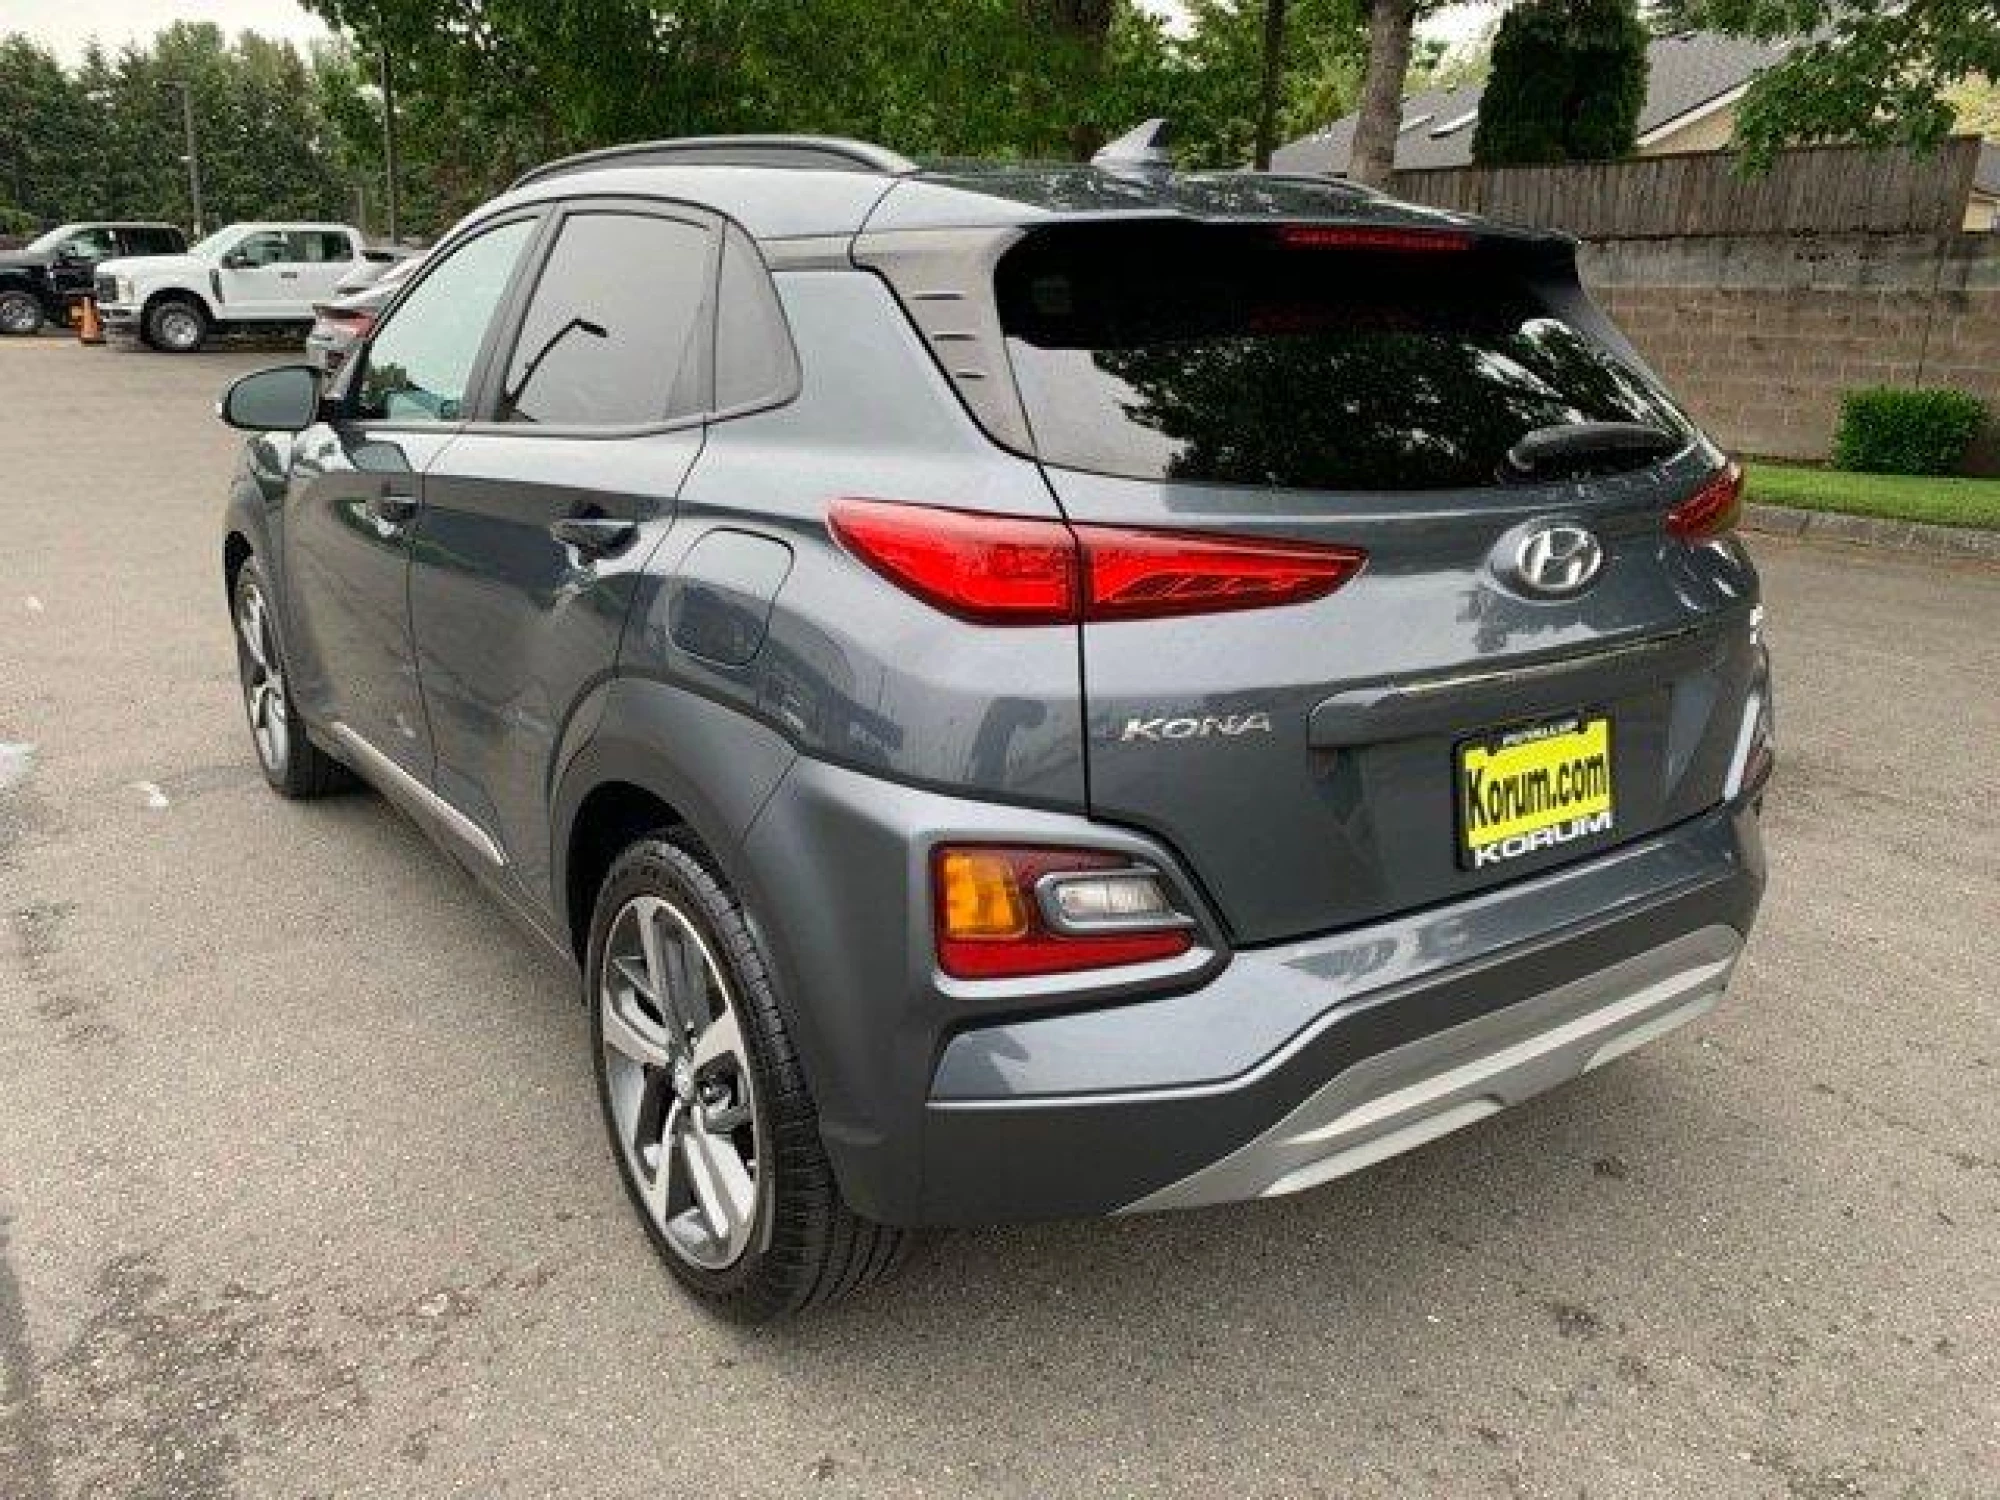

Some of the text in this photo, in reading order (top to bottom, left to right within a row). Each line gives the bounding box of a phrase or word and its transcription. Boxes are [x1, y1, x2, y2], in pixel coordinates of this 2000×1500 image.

[1120, 712, 1273, 741] KONA
[1466, 753, 1605, 829] Korum.com
[1475, 811, 1613, 869] KORUM
